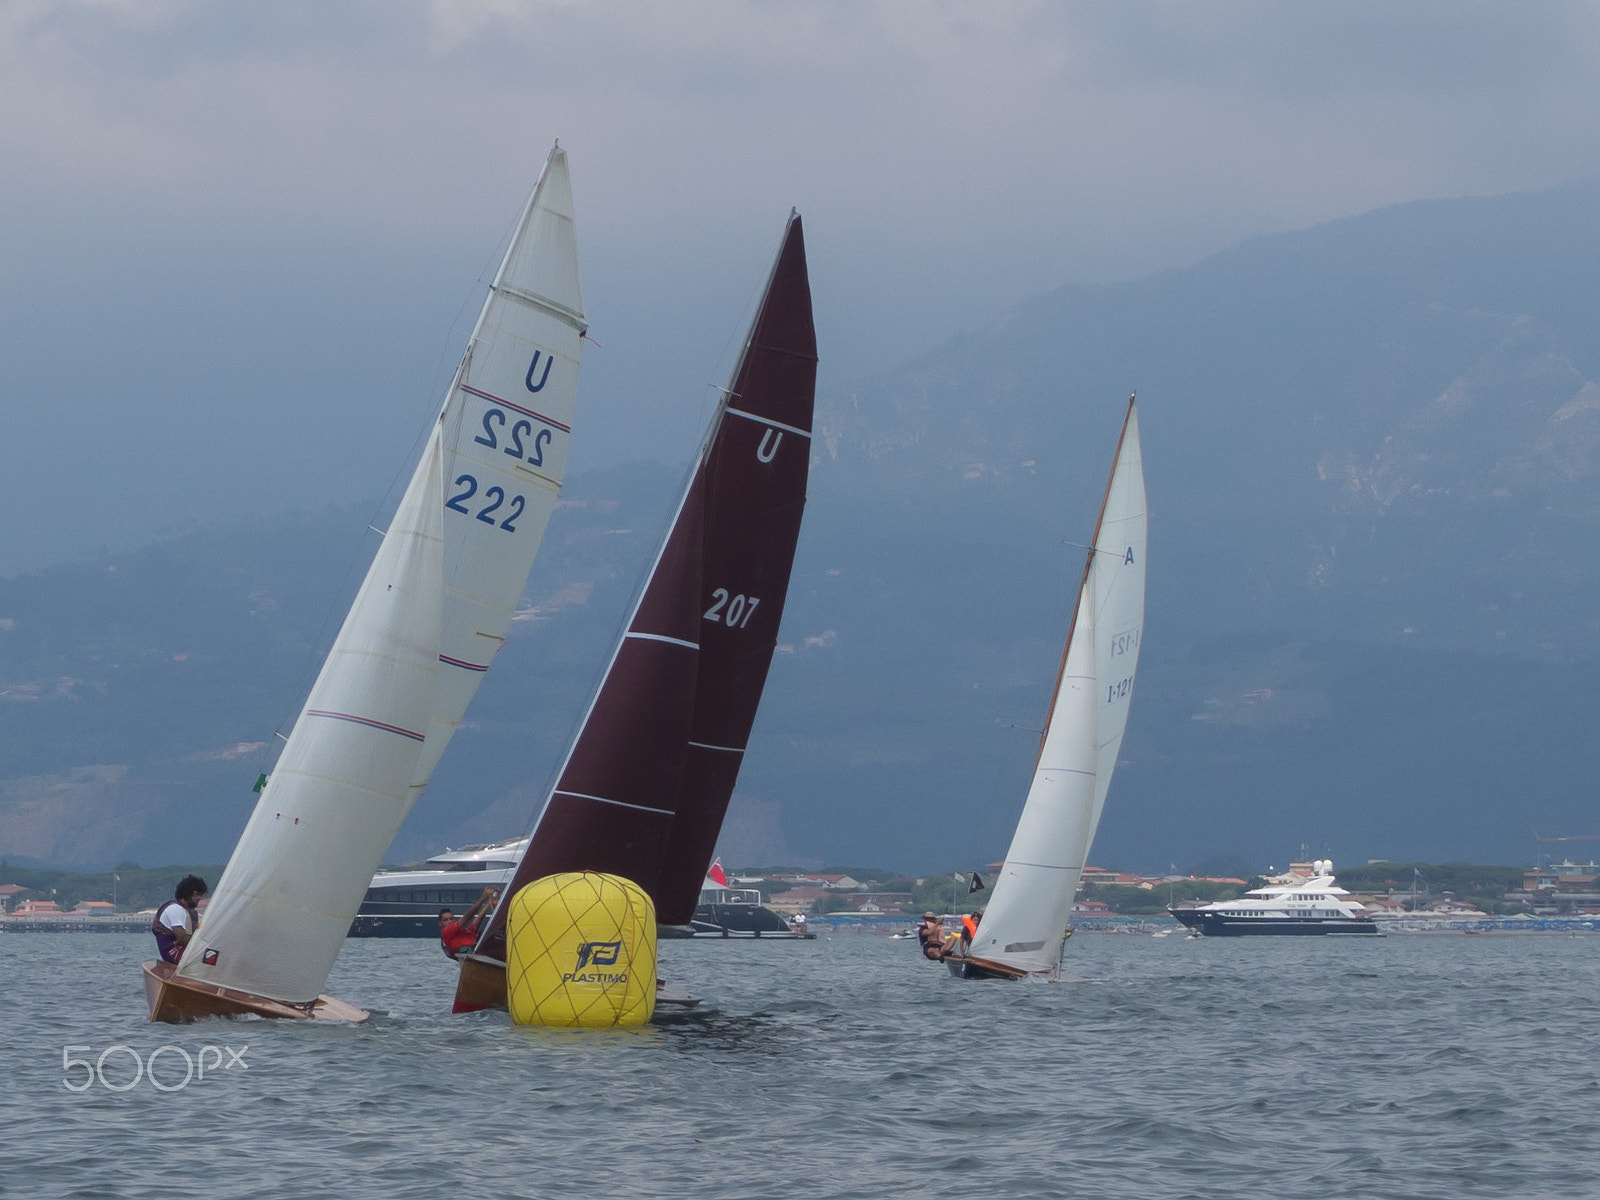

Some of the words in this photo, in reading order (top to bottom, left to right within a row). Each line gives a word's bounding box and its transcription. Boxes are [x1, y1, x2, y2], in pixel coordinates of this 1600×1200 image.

[525, 349, 554, 393] U
[756, 428, 784, 463] U
[445, 474, 525, 533] 222
[1124, 546, 1134, 565] A
[703, 588, 760, 628] 207
[563, 972, 628, 984] PLASTIMO
